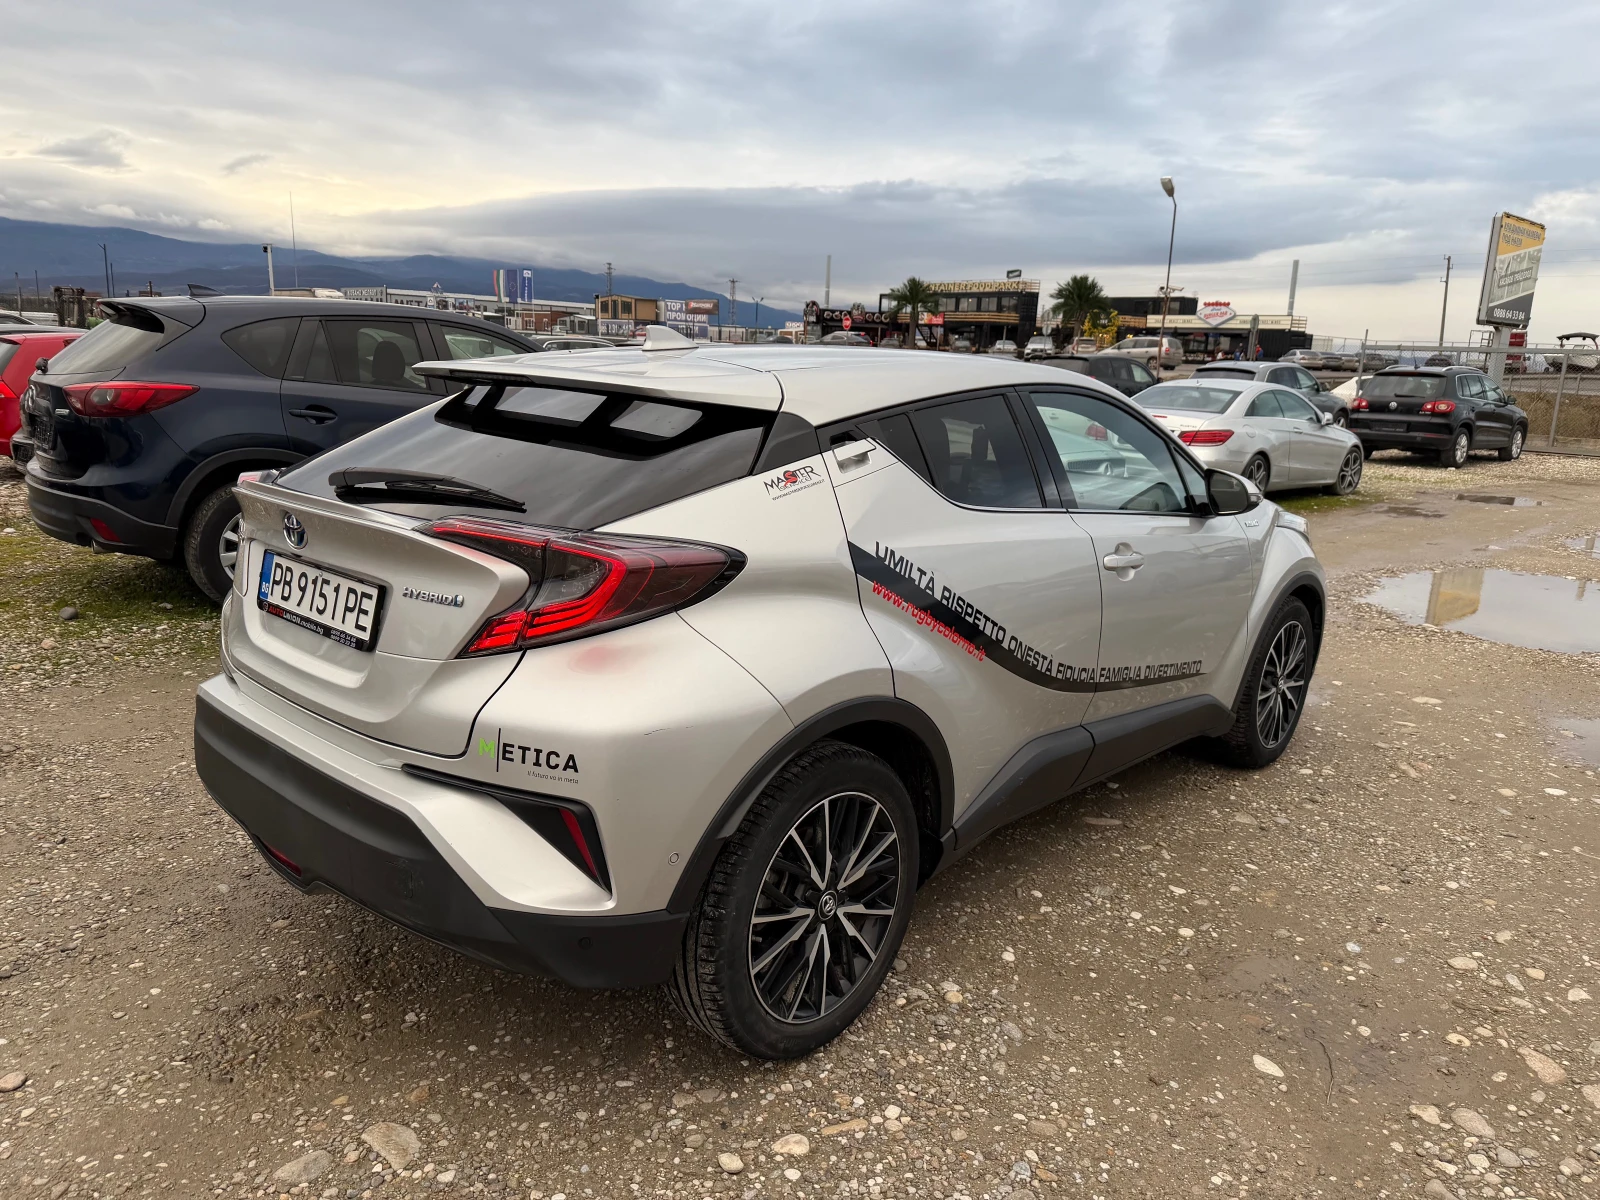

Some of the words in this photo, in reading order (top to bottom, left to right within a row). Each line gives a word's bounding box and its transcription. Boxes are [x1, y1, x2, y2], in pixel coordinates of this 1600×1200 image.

[968, 282, 992, 291] FOOD
[993, 281, 1019, 290] PARK
[1506, 309, 1513, 319] 64
[1512, 311, 1519, 320] 33
[763, 465, 821, 495] MASTER
[261, 581, 269, 593] BG
[270, 562, 294, 602] PB
[297, 571, 341, 620] 9151
[342, 586, 374, 633] PE
[871, 580, 986, 662] www.rugbycolorno.it
[875, 541, 935, 597] UMILTÀ
[940, 585, 1007, 646] RISPETTO
[1008, 635, 1054, 675] ONESTÀ
[1056, 662, 1096, 683] FIDUCIA
[1099, 665, 1142, 683] FAMIGLIA
[1144, 660, 1202, 680] DIVERTIMENTO
